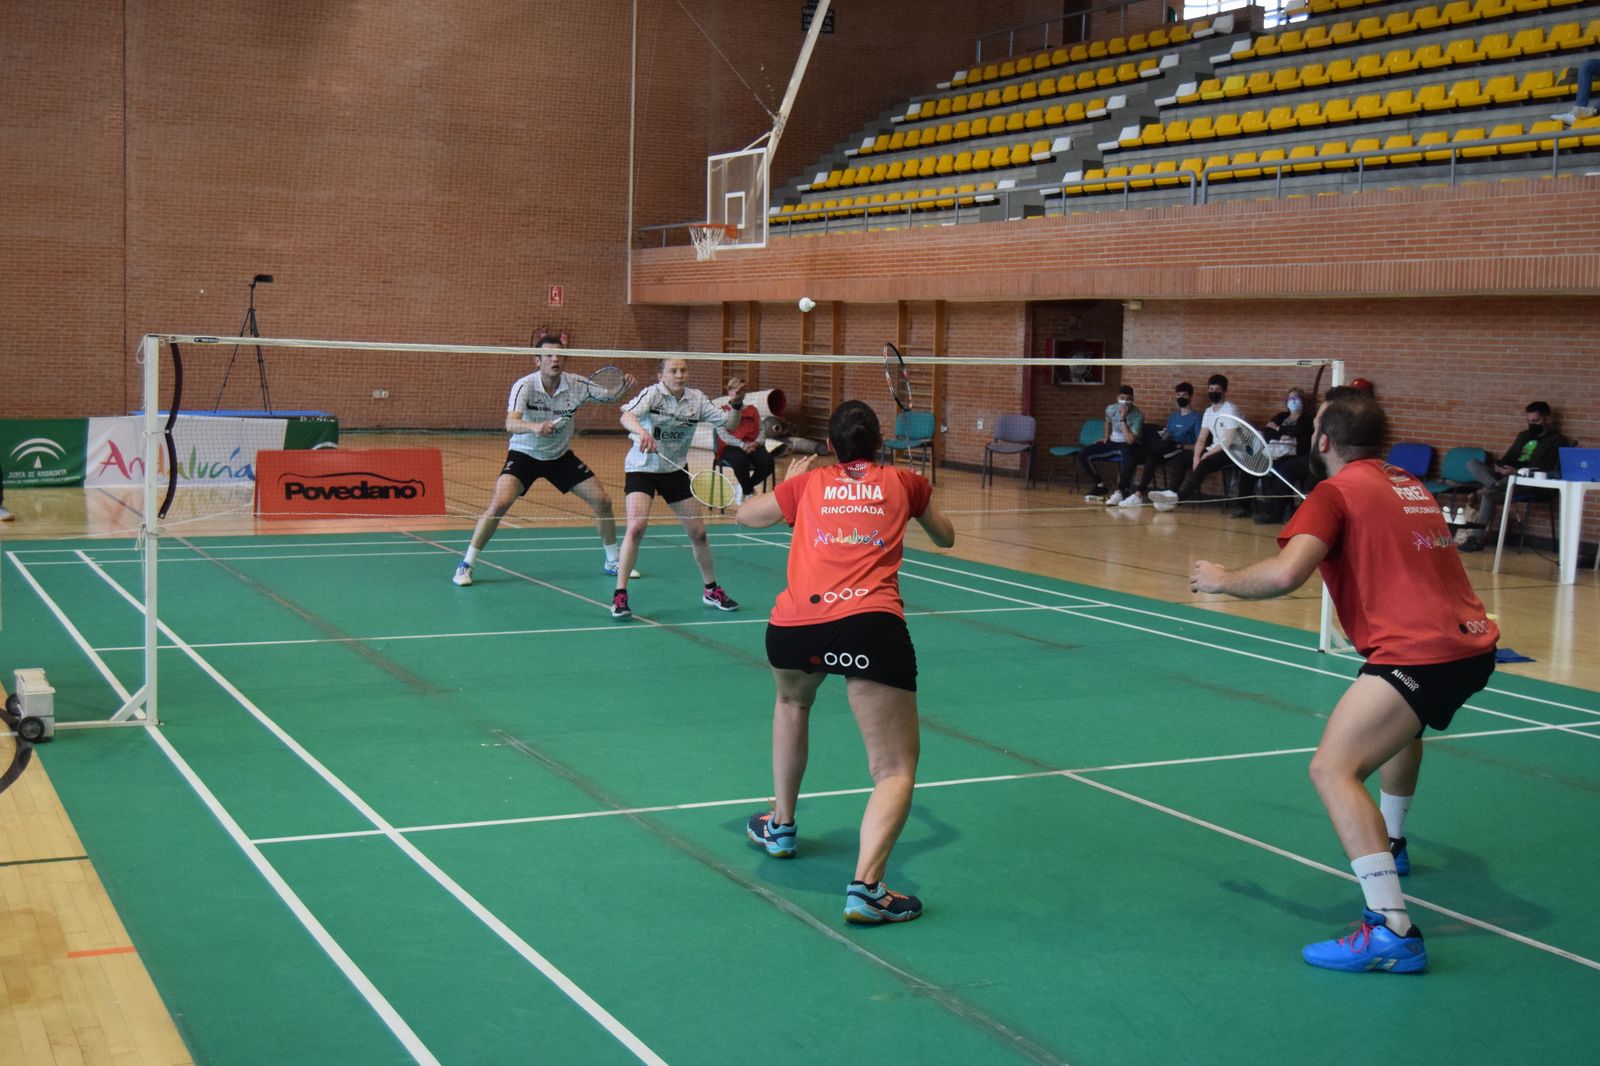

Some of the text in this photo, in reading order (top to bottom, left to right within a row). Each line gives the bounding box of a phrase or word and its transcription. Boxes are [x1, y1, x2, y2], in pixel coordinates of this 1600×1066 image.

[8, 471, 26, 479] JUNTA
[285, 480, 417, 500] Povedano
[823, 482, 884, 501] MOLINA
[821, 505, 885, 517] RINCONADA
[813, 527, 887, 551] Andalucía
